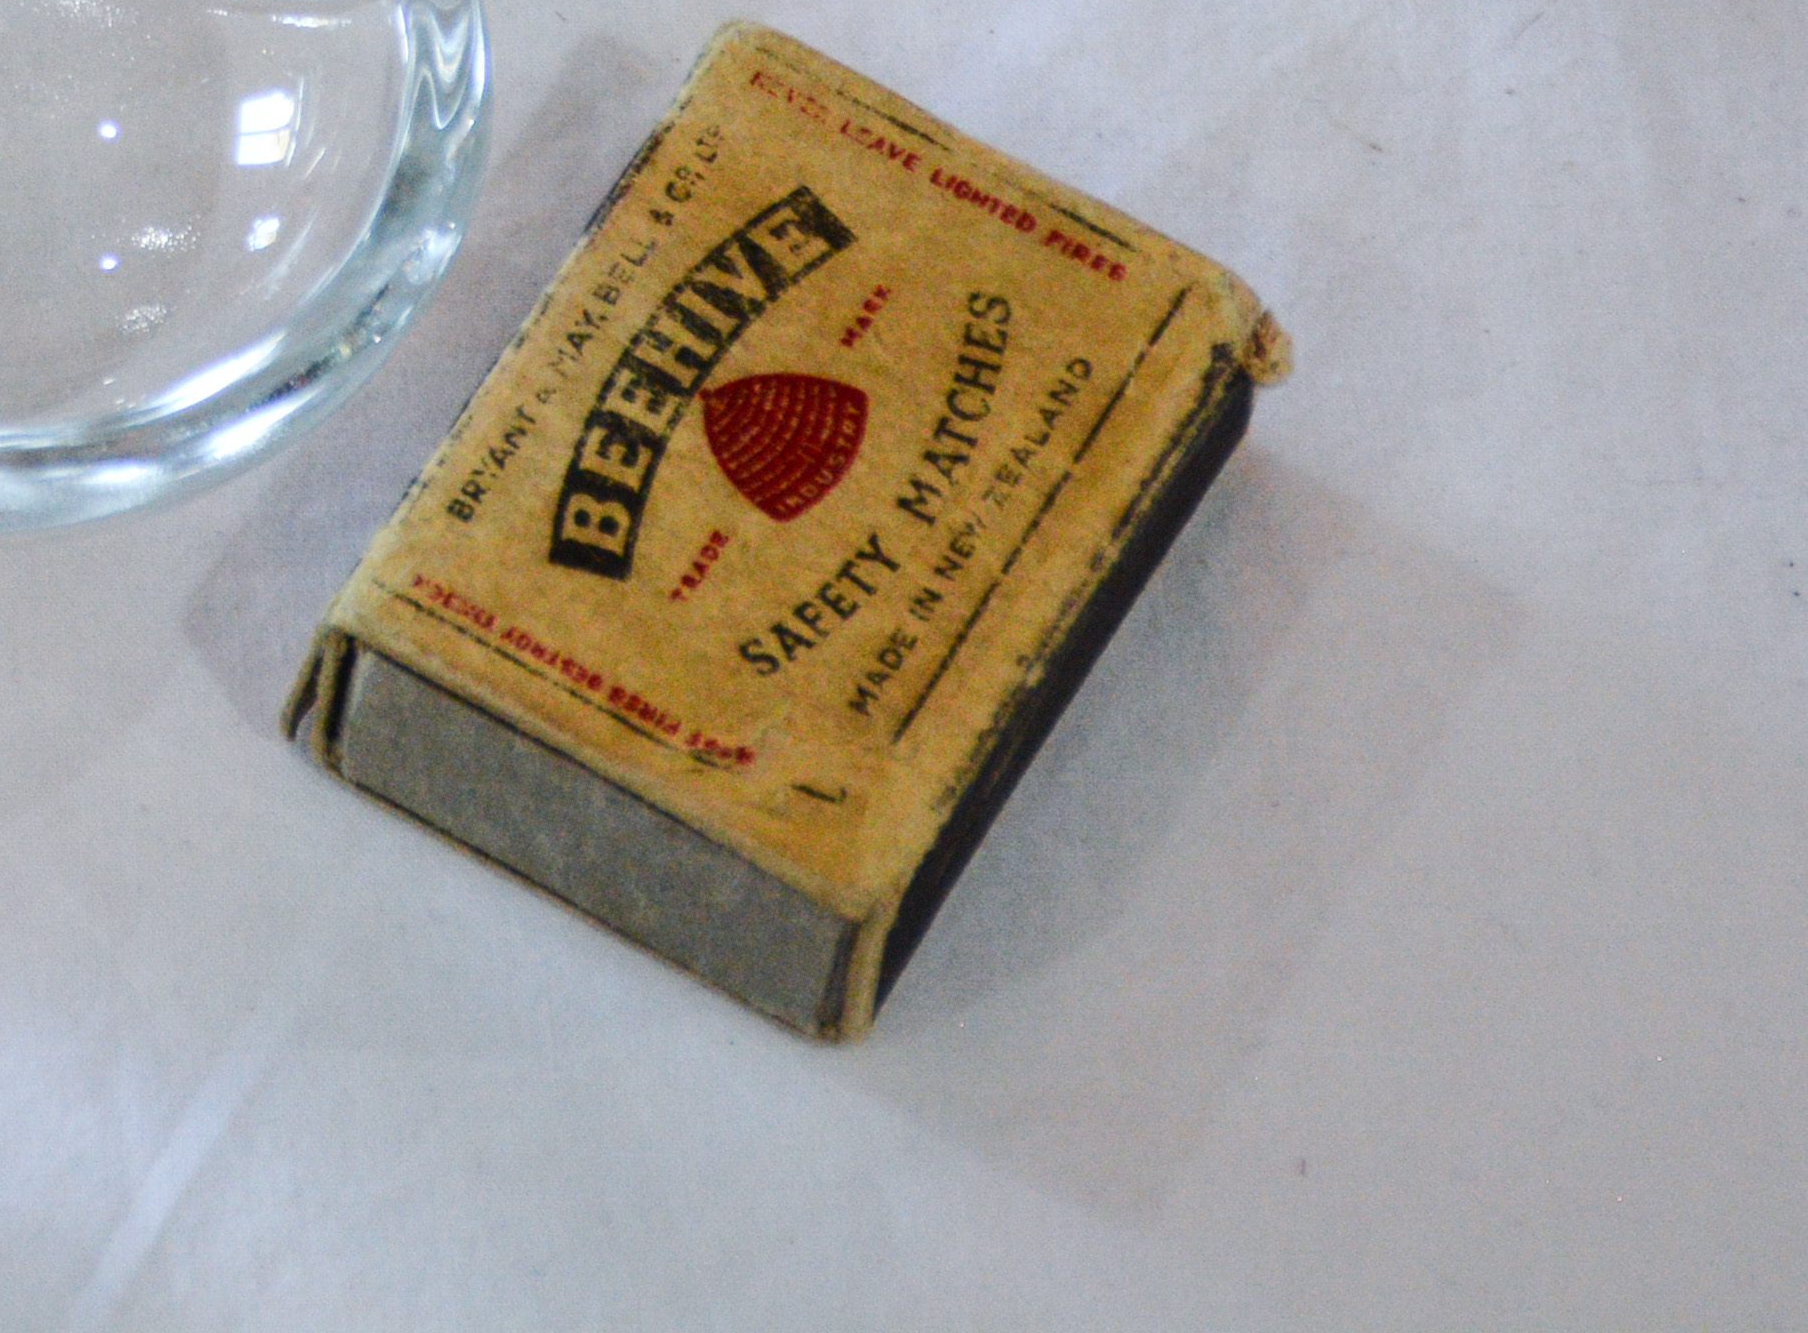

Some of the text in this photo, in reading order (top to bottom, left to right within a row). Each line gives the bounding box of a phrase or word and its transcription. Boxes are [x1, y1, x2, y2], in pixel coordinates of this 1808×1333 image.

[840, 120, 922, 172] LEAVE
[930, 167, 1037, 233] LIGHTED
[1041, 230, 1127, 282] FIRES
[446, 405, 536, 522] BRYANT
[649, 209, 675, 226] &
[559, 201, 832, 561] BEEHIVE
[668, 284, 891, 602] TRADE MARK
[739, 290, 1012, 676] SAFETY MATCHES
[774, 400, 862, 513] INDUSTRY
[849, 358, 1094, 716] MADE IN NEW ZEALAND
